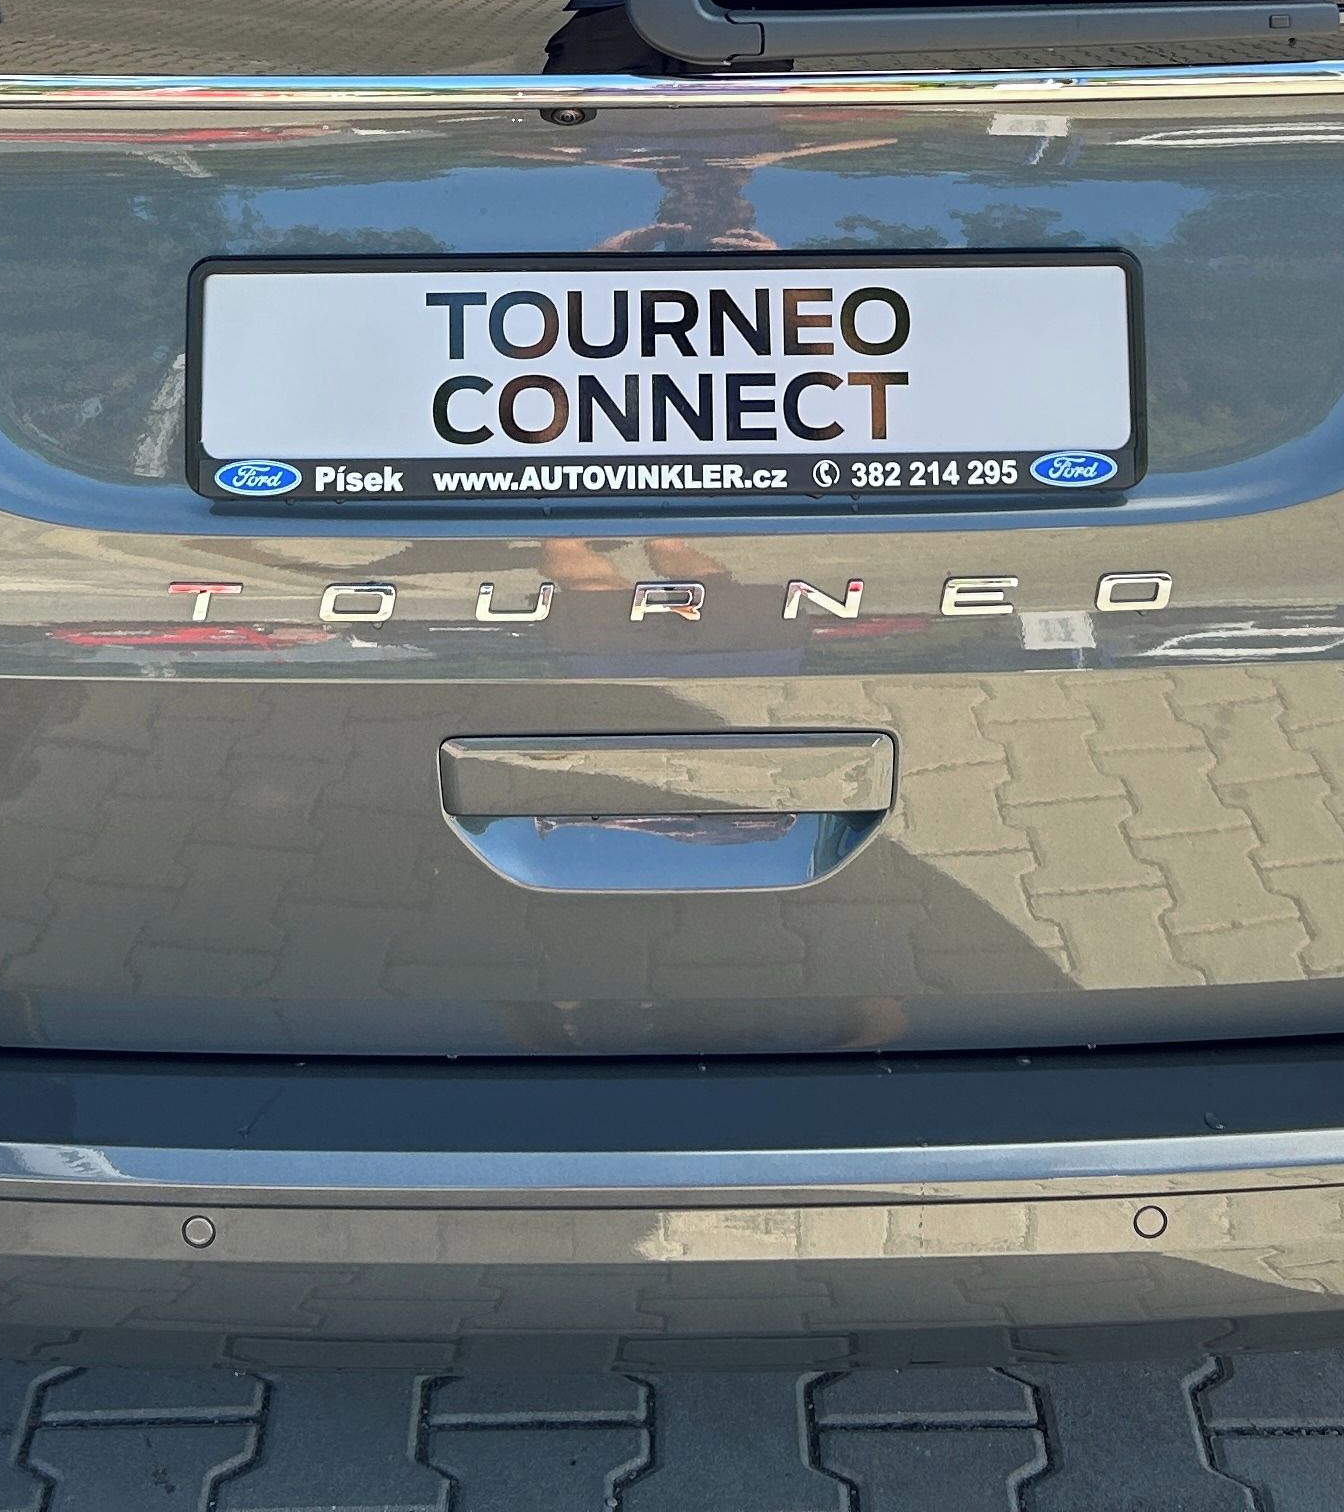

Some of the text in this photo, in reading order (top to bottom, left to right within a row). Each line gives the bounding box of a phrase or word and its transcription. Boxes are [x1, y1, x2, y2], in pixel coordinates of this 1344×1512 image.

[425, 286, 911, 360] TOURNEO
[431, 371, 910, 446] CONNECT
[315, 465, 404, 493] Písek
[432, 461, 787, 492] www.AUTOVINKLER.cz
[851, 461, 902, 487] 382
[909, 460, 960, 486] 214
[967, 459, 1018, 485] 295
[166, 570, 1175, 624] TOURNEO
